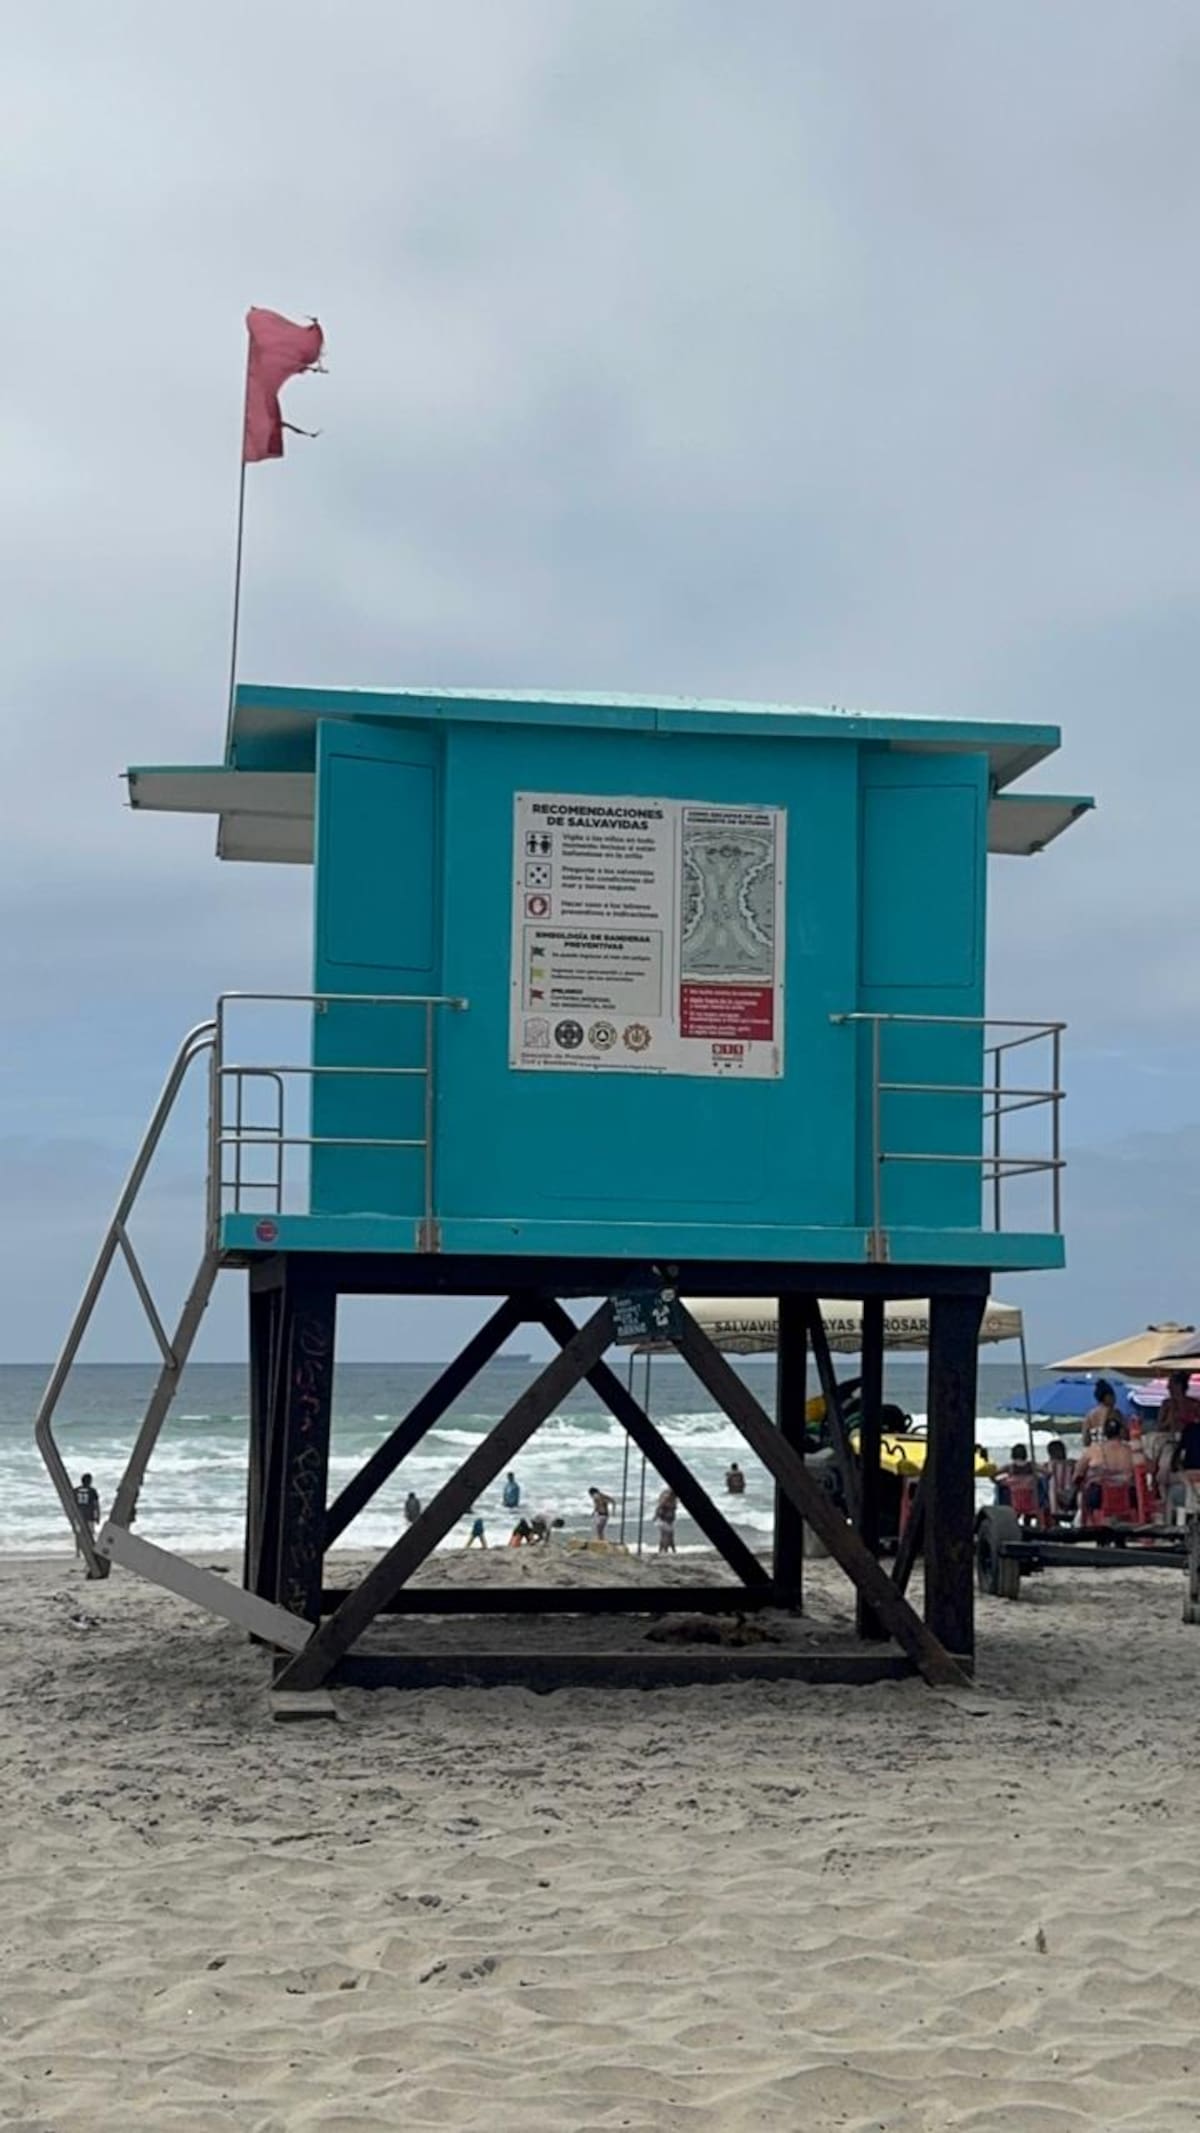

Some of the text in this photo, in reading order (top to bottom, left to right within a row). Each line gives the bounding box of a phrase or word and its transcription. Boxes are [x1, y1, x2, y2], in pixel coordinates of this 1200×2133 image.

[532, 804, 664, 819] RECOMENDACIONES
[546, 816, 649, 830] DE SALVAVIDAS
[590, 932, 602, 941] DE
[604, 933, 651, 943] BANDERAS
[564, 941, 624, 950] PREVENTIVAS
[714, 1320, 779, 1333] SALVAVID
[884, 1319, 929, 1332] ROSAR
